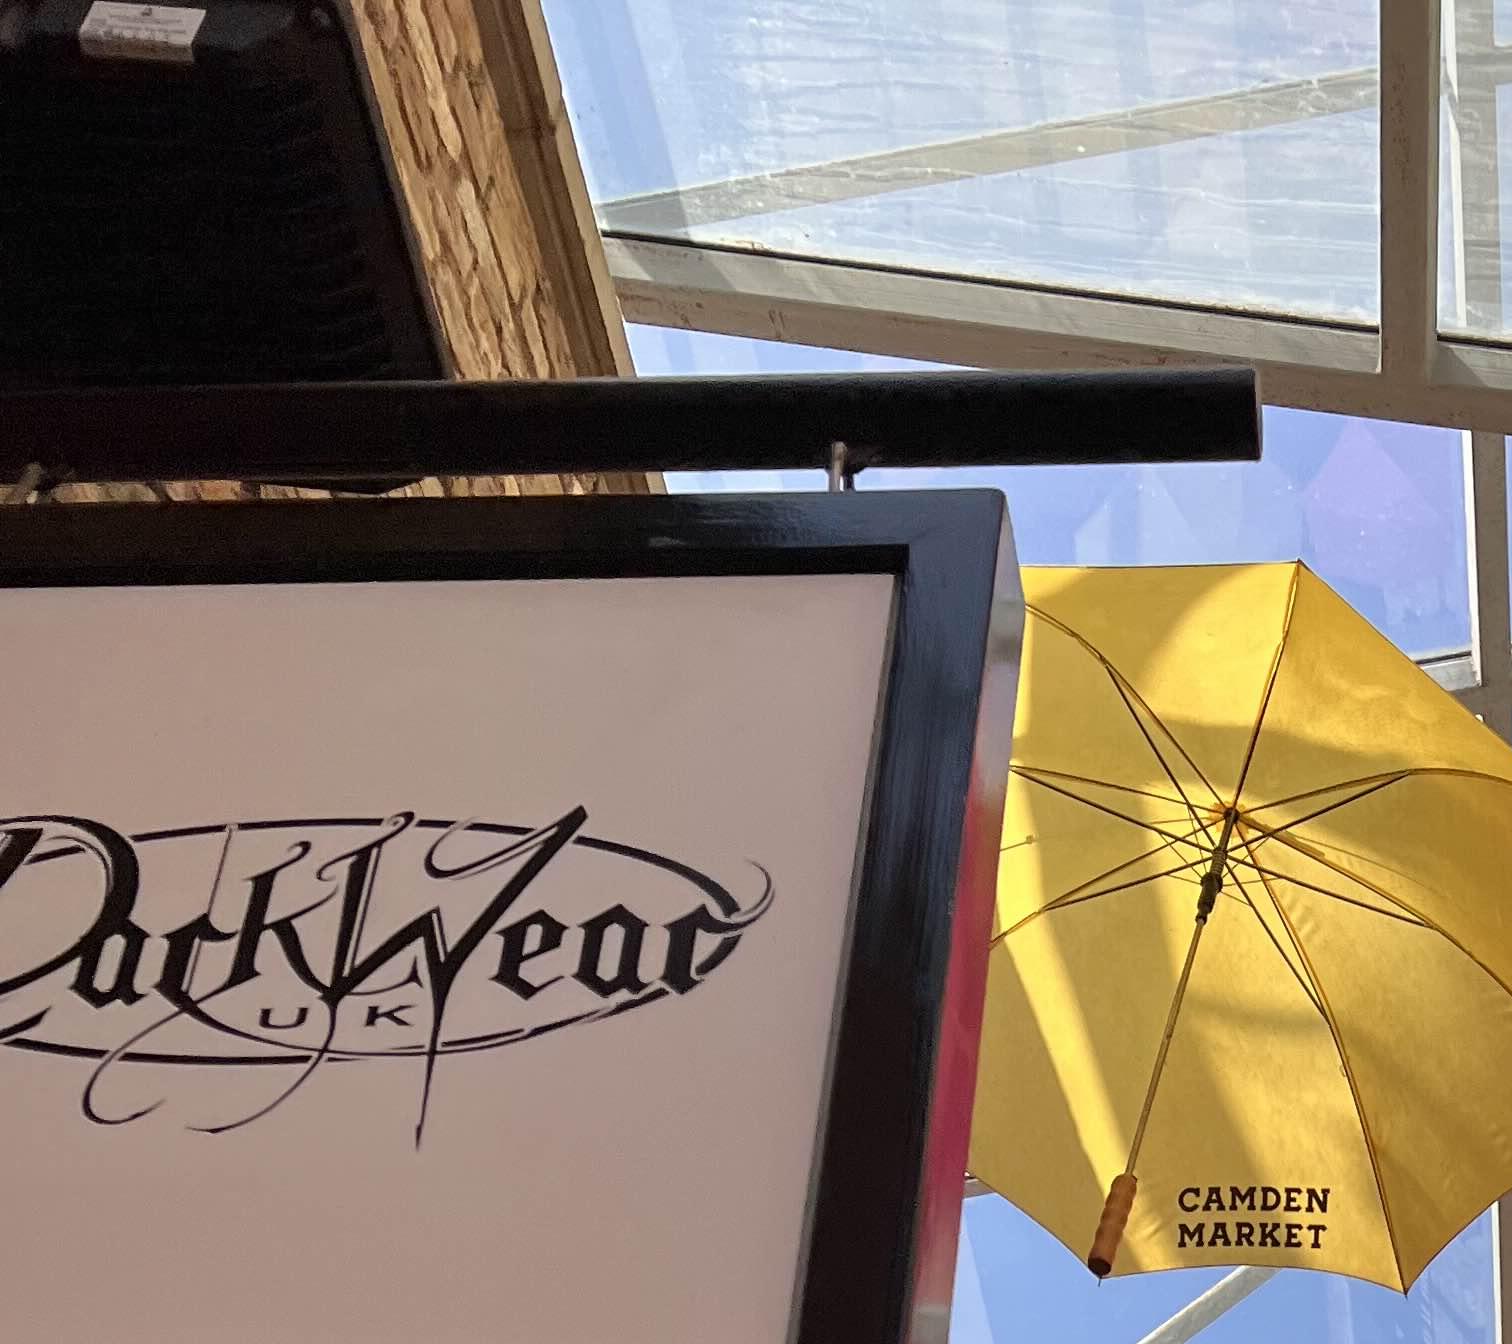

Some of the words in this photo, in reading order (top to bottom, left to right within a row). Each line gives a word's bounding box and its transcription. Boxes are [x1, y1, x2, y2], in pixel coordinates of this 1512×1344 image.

[257, 1005, 413, 1028] UK
[1177, 1186, 1332, 1214] CAMDEN
[1177, 1222, 1328, 1249] MARKET
